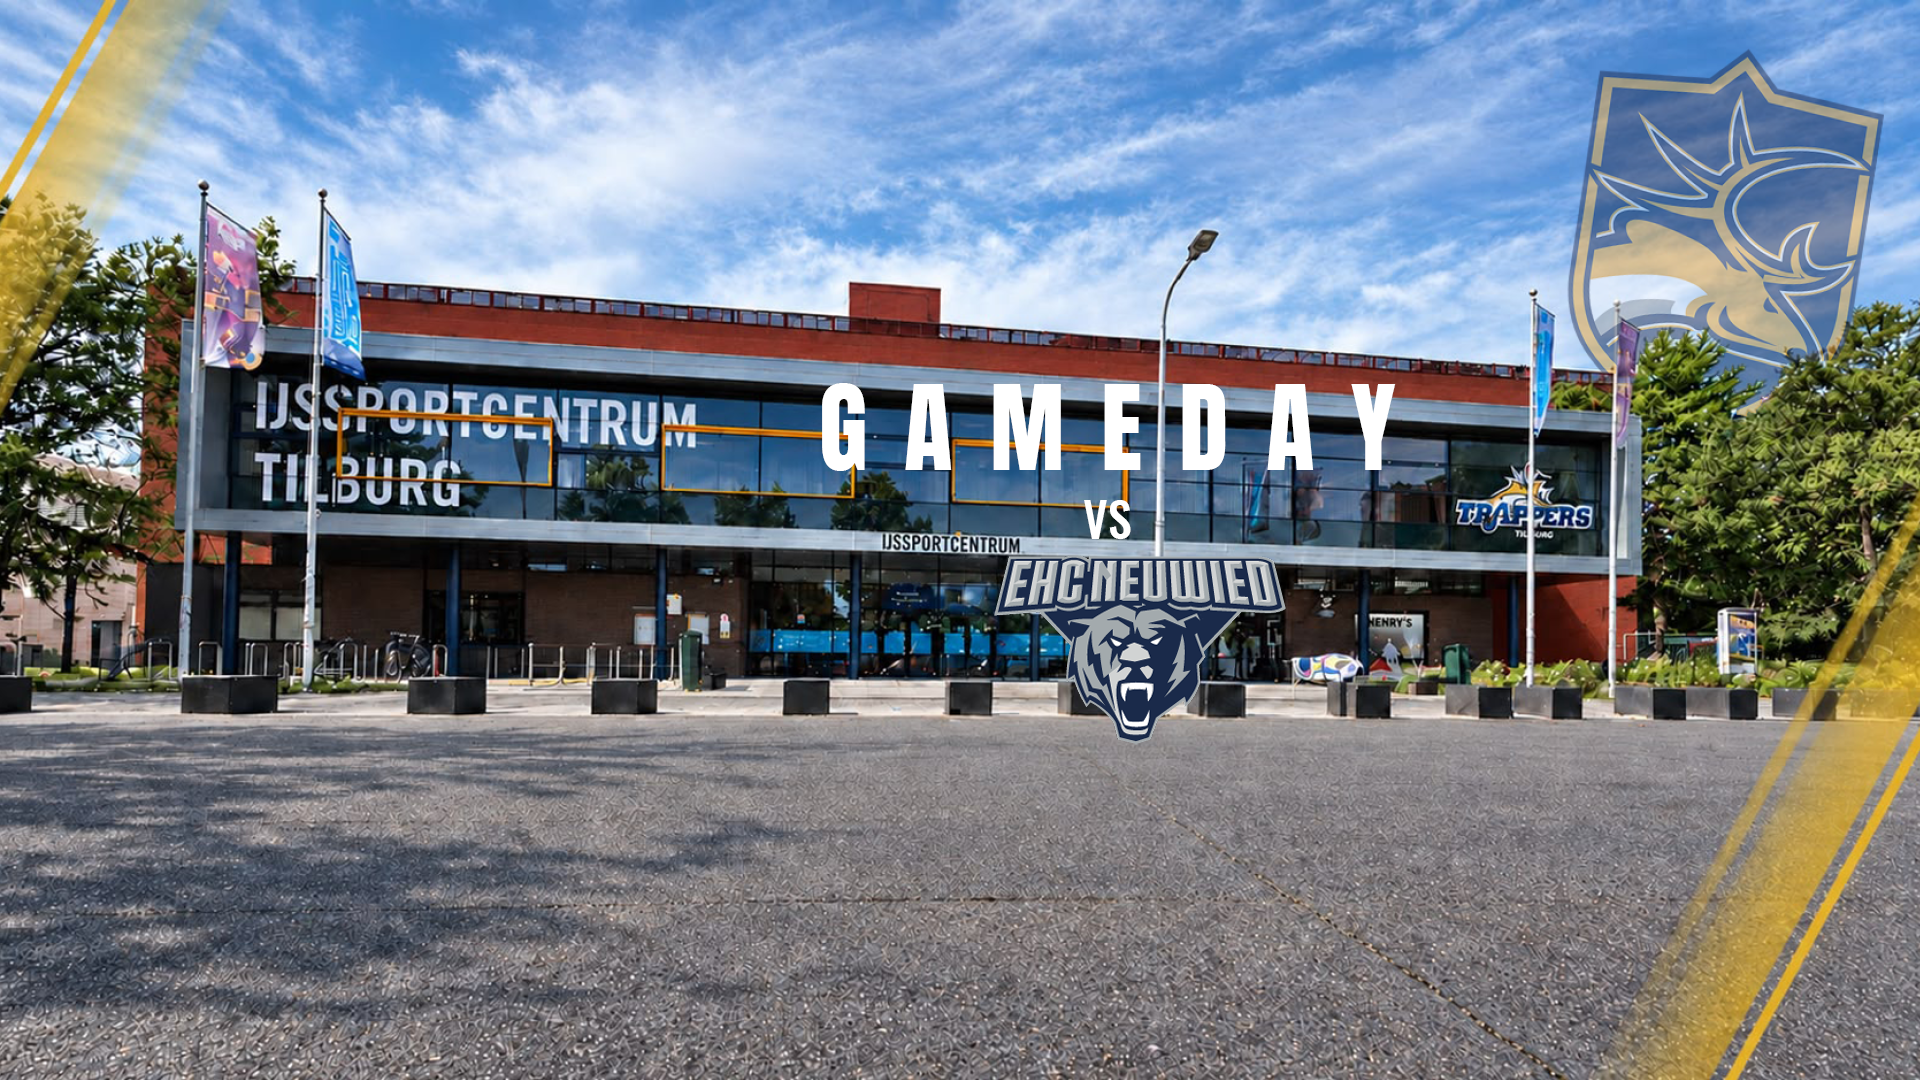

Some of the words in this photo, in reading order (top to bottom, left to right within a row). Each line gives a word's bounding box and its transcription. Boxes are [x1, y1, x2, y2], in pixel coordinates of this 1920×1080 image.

[255, 381, 697, 449] IJSSPORTCENTRUM
[254, 452, 461, 507] TILBURG
[881, 533, 1021, 554] IJSSPORTCENTRUM
[1514, 529, 1554, 539] TILURG
